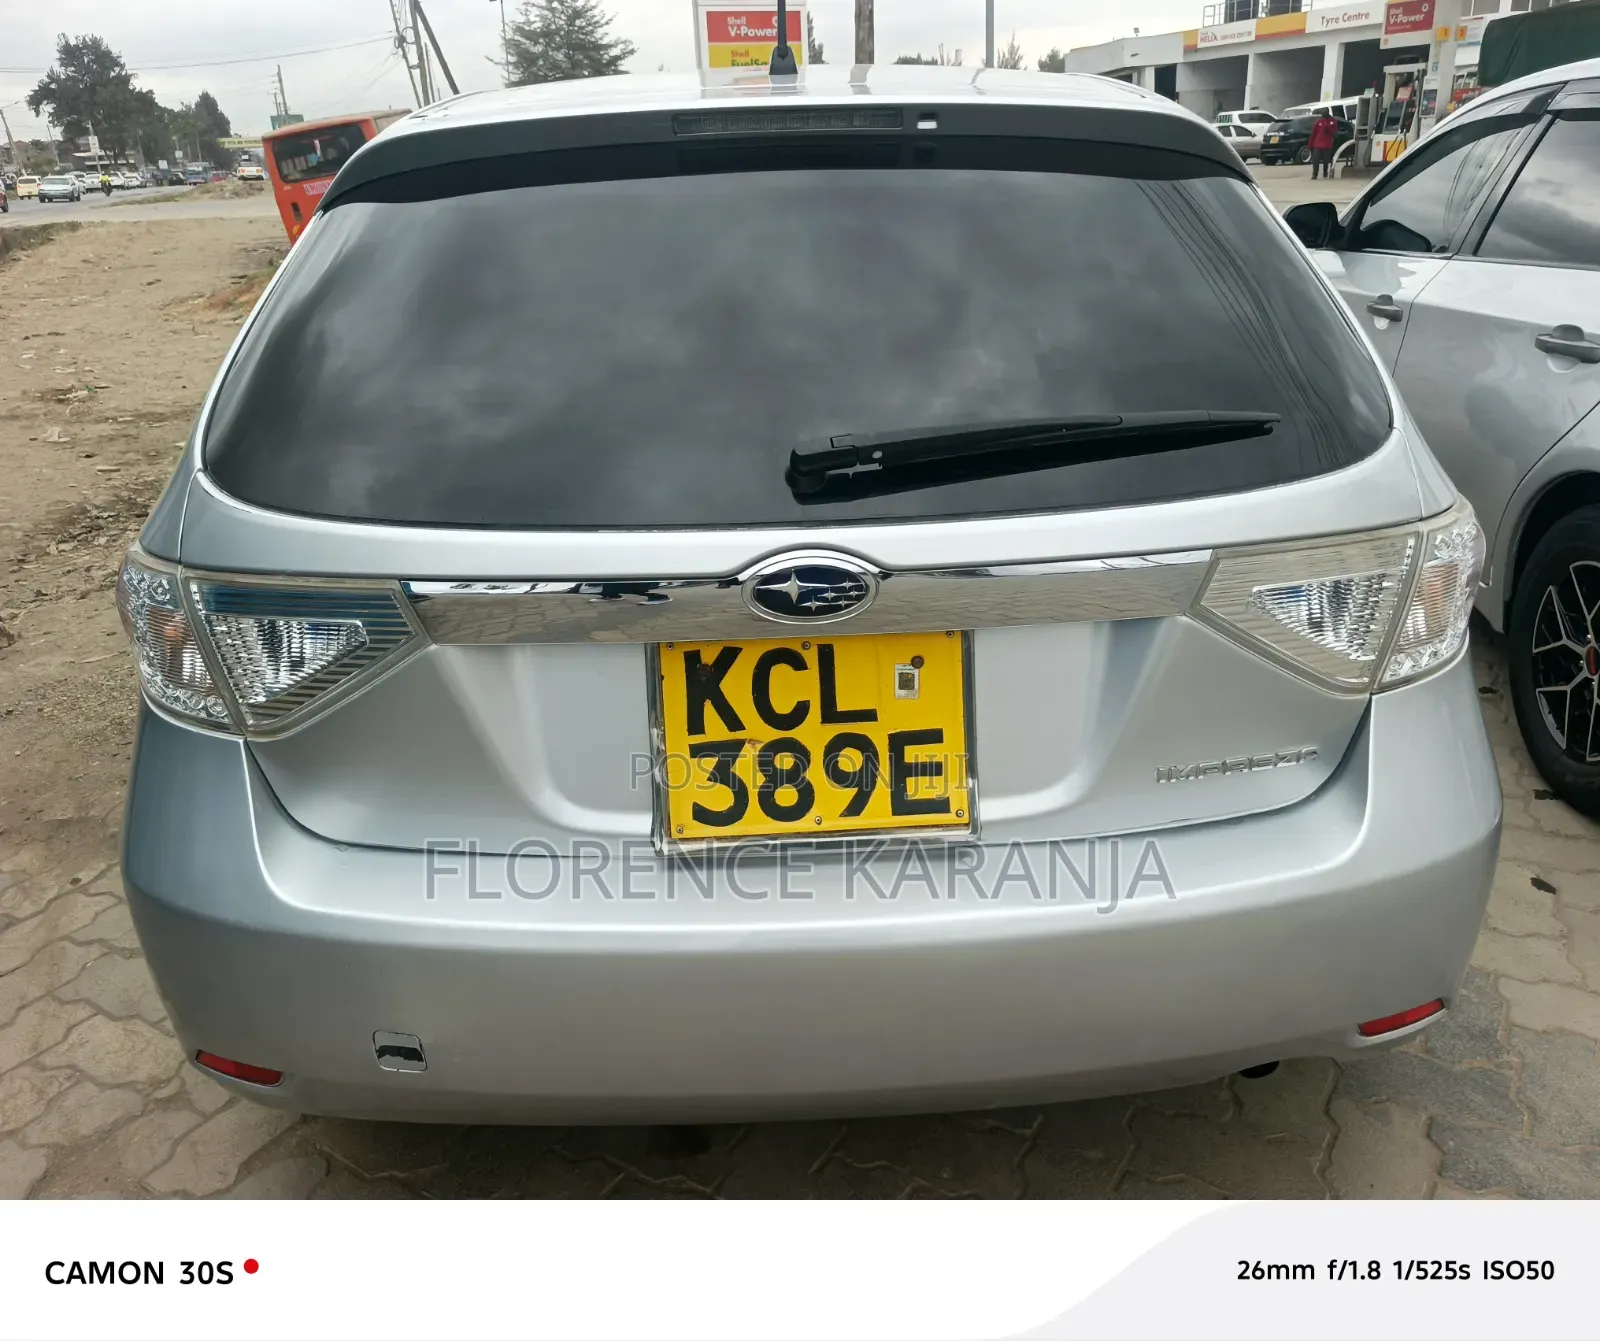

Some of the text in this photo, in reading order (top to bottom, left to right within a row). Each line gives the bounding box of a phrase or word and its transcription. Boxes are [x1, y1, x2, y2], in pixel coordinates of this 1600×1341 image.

[727, 15, 746, 25] Shell
[1320, 11, 1370, 27] Tyre Centre
[1389, 13, 1425, 24] V-Power
[728, 26, 778, 36] V-Power
[731, 50, 749, 58] Shell
[731, 58, 769, 67] FuelSa
[683, 643, 878, 736] KCL
[1156, 745, 1318, 783] IMPREZA
[689, 728, 952, 827] 389E
